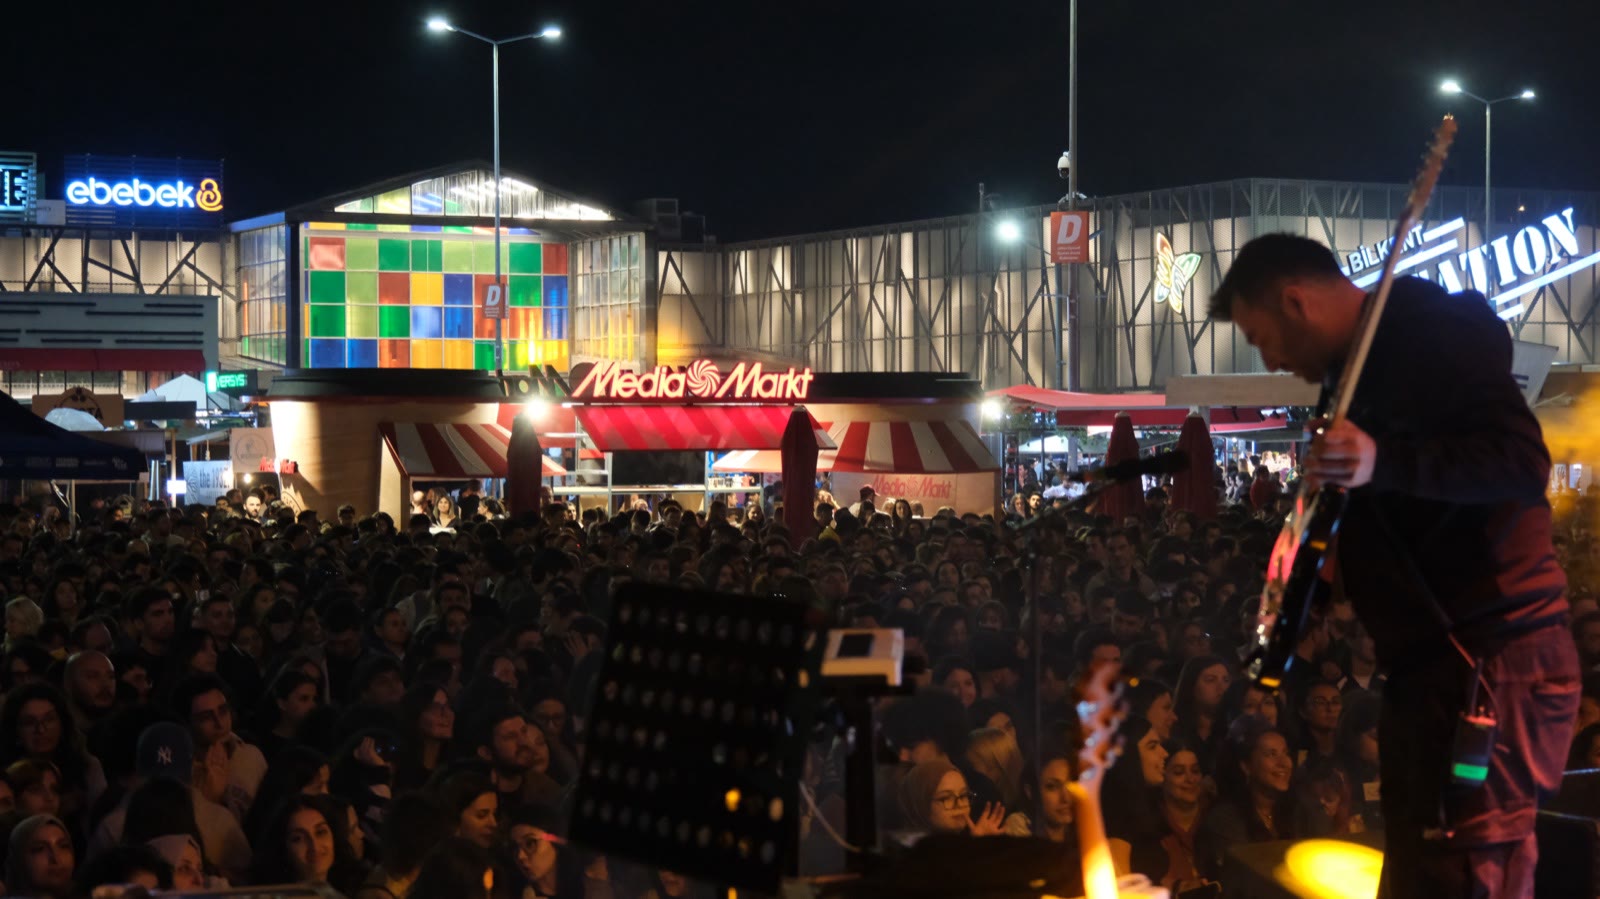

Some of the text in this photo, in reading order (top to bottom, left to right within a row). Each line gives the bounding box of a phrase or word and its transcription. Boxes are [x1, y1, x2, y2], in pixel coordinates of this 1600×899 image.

[67, 177, 195, 208] ebebek
[1056, 214, 1082, 245] D
[1348, 224, 1423, 274] BİLKNT
[486, 285, 501, 307] D
[572, 361, 685, 399] Media
[715, 362, 814, 399] Markt
